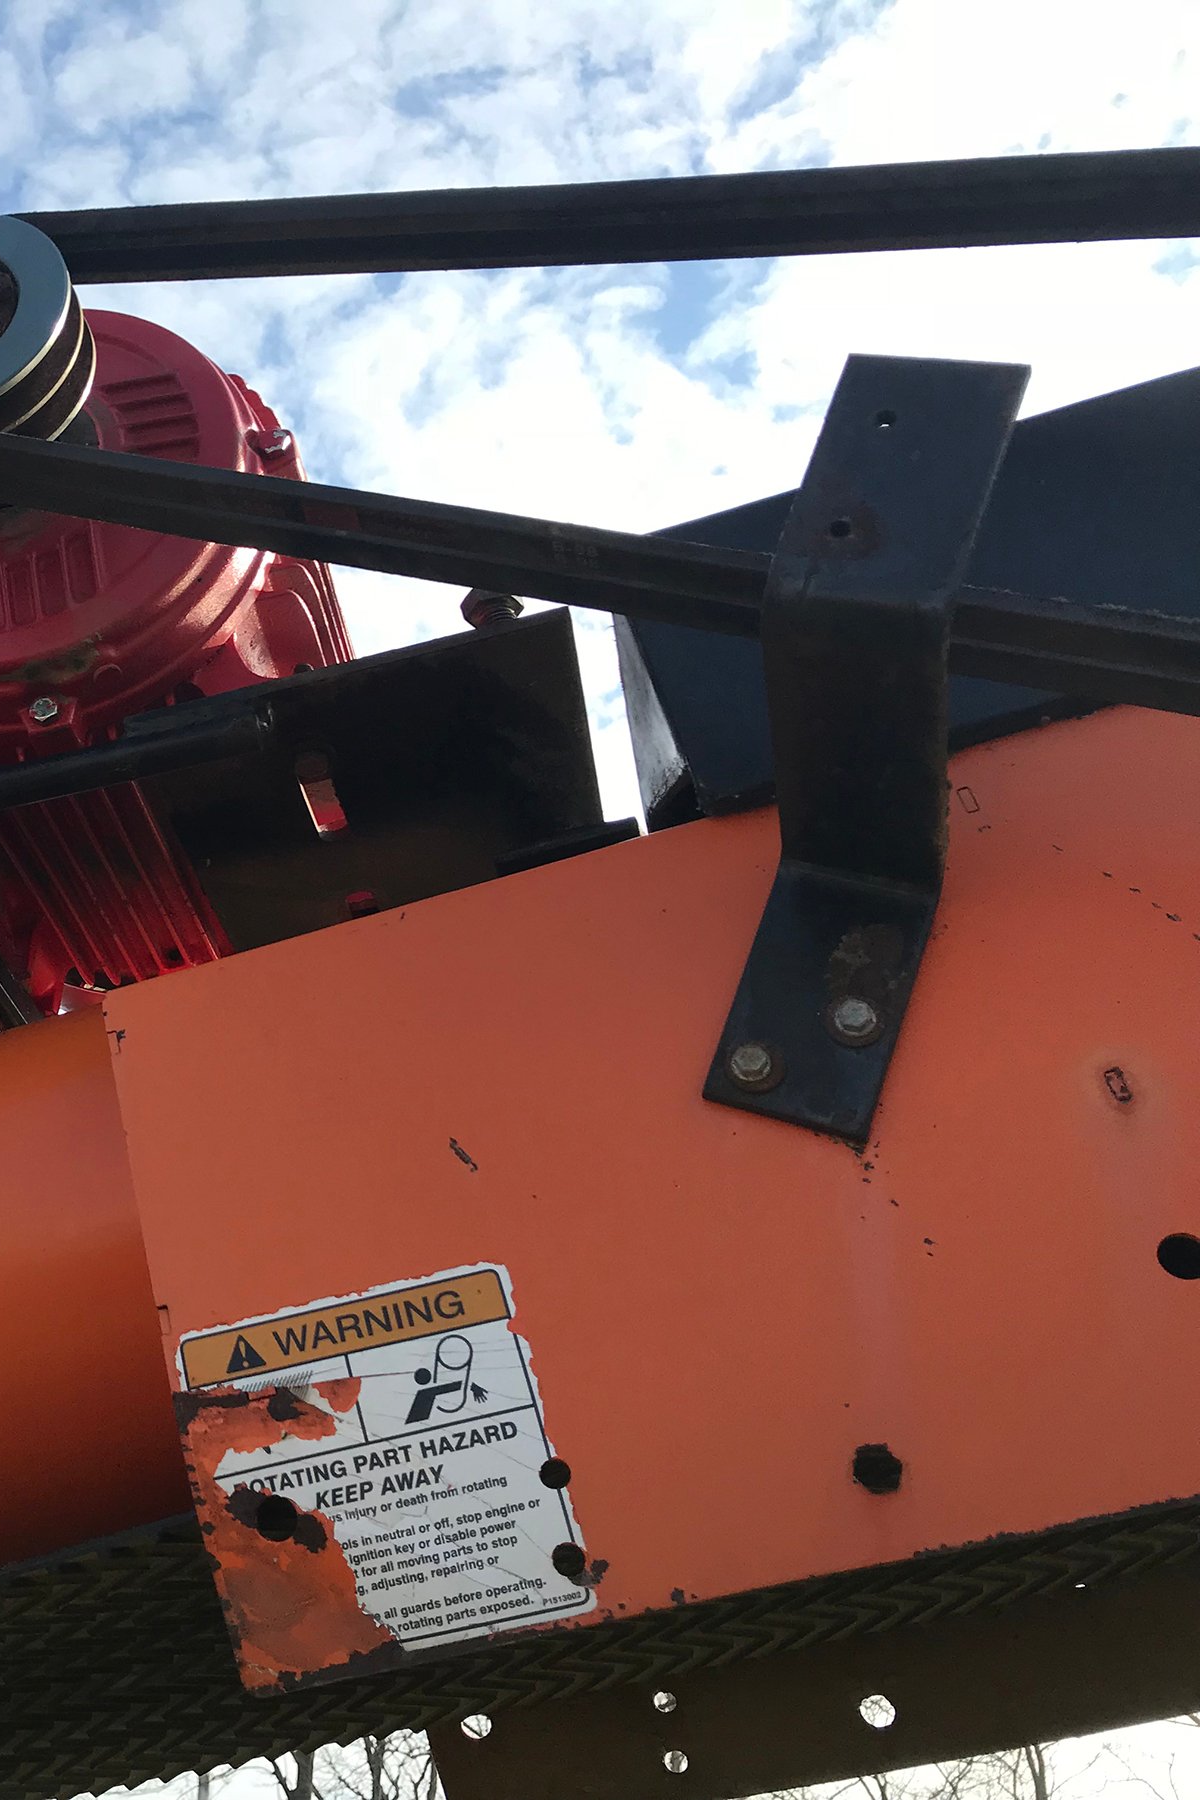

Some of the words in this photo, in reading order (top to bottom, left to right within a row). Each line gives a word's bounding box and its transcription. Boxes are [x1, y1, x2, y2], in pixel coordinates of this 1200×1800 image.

[272, 1289, 466, 1356] WARNING
[353, 1444, 413, 1473] PART
[419, 1421, 518, 1459] HAZARD
[316, 1480, 374, 1510] KEEP
[381, 1464, 444, 1496] AWAY
[345, 1505, 377, 1521] injury
[380, 1502, 392, 1513] or
[395, 1493, 429, 1509] death
[431, 1488, 459, 1503] from
[461, 1476, 508, 1494] rotating
[349, 1547, 392, 1565] ignition
[394, 1542, 415, 1556] key
[418, 1538, 431, 1549] or
[433, 1529, 477, 1546] disable
[480, 1520, 517, 1538] power
[361, 1536, 373, 1547] in
[375, 1525, 416, 1543] neutral
[418, 1523, 431, 1534] or
[434, 1517, 454, 1530] off,
[456, 1511, 483, 1526] stop
[485, 1503, 526, 1519] engine
[528, 1498, 541, 1509] or
[355, 1585, 369, 1596] g,
[371, 1570, 429, 1591] adjusting,
[430, 1558, 485, 1578] repairing
[487, 1556, 500, 1566] or
[361, 1566, 377, 1578] for
[380, 1560, 395, 1574] all
[397, 1553, 440, 1570] moving
[443, 1544, 474, 1562] parts
[476, 1541, 488, 1552] to
[491, 1534, 518, 1549] stop
[384, 1606, 398, 1620] all
[400, 1600, 442, 1619] guards
[444, 1590, 483, 1607] before
[485, 1576, 547, 1599] operating.
[397, 1614, 444, 1632] rotating
[447, 1607, 477, 1624] parts
[479, 1595, 535, 1615] exposed.
